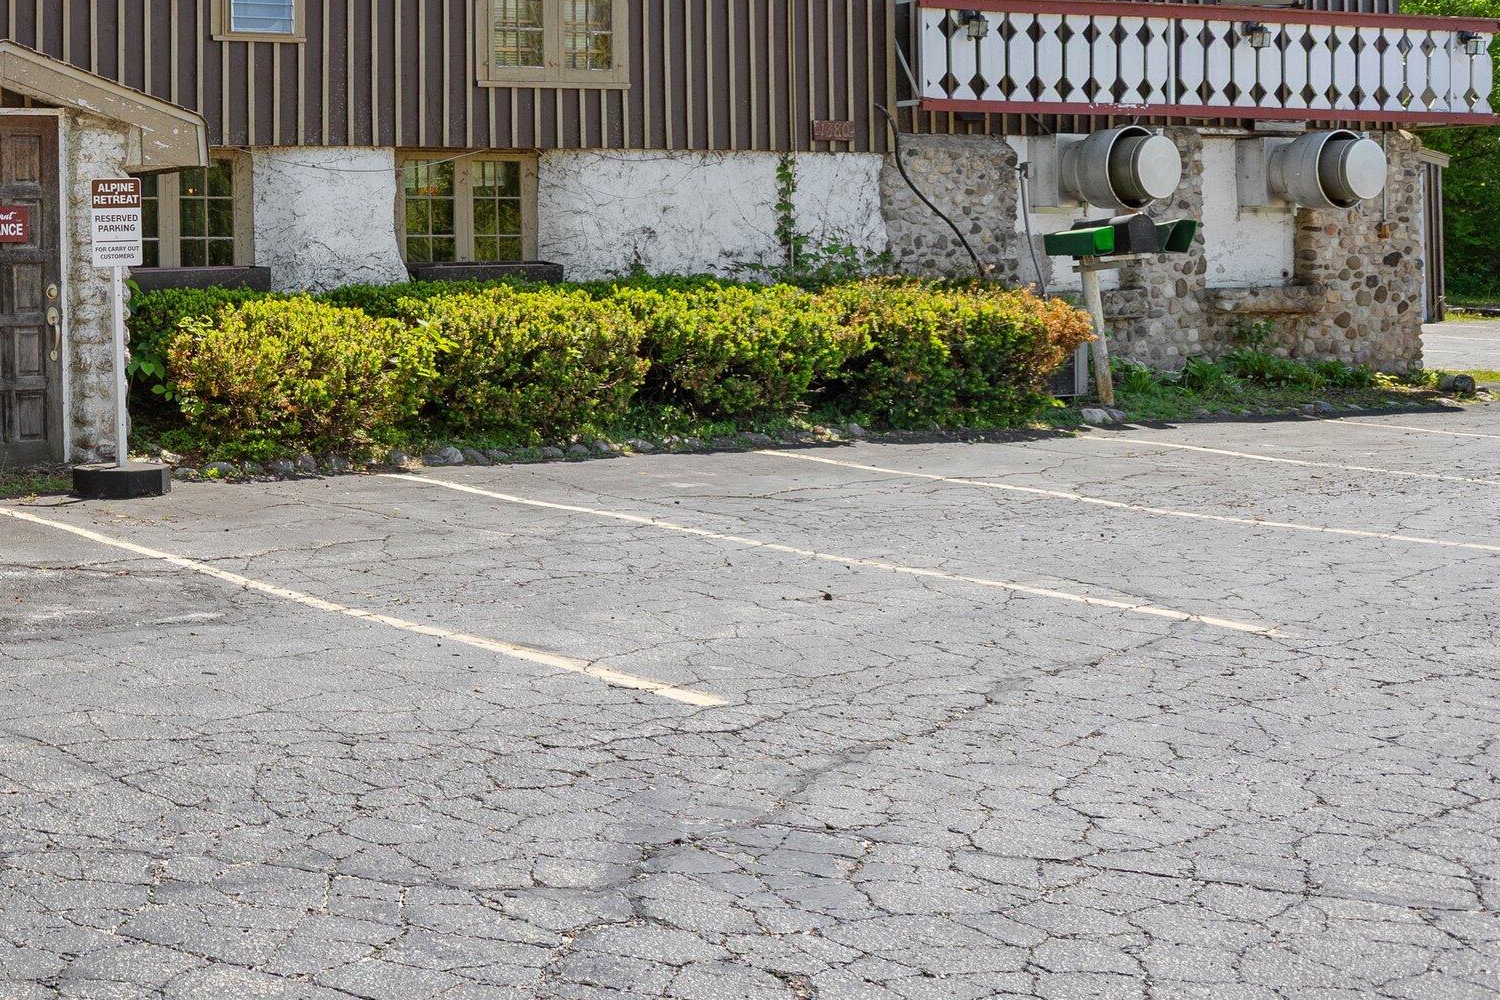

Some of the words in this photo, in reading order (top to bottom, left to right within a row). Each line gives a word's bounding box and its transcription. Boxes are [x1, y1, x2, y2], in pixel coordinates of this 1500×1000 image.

[820, 122, 850, 138] 1380
[98, 183, 134, 192] ALPINE
[93, 195, 138, 204] RETREAT
[98, 224, 136, 232] PARKING
